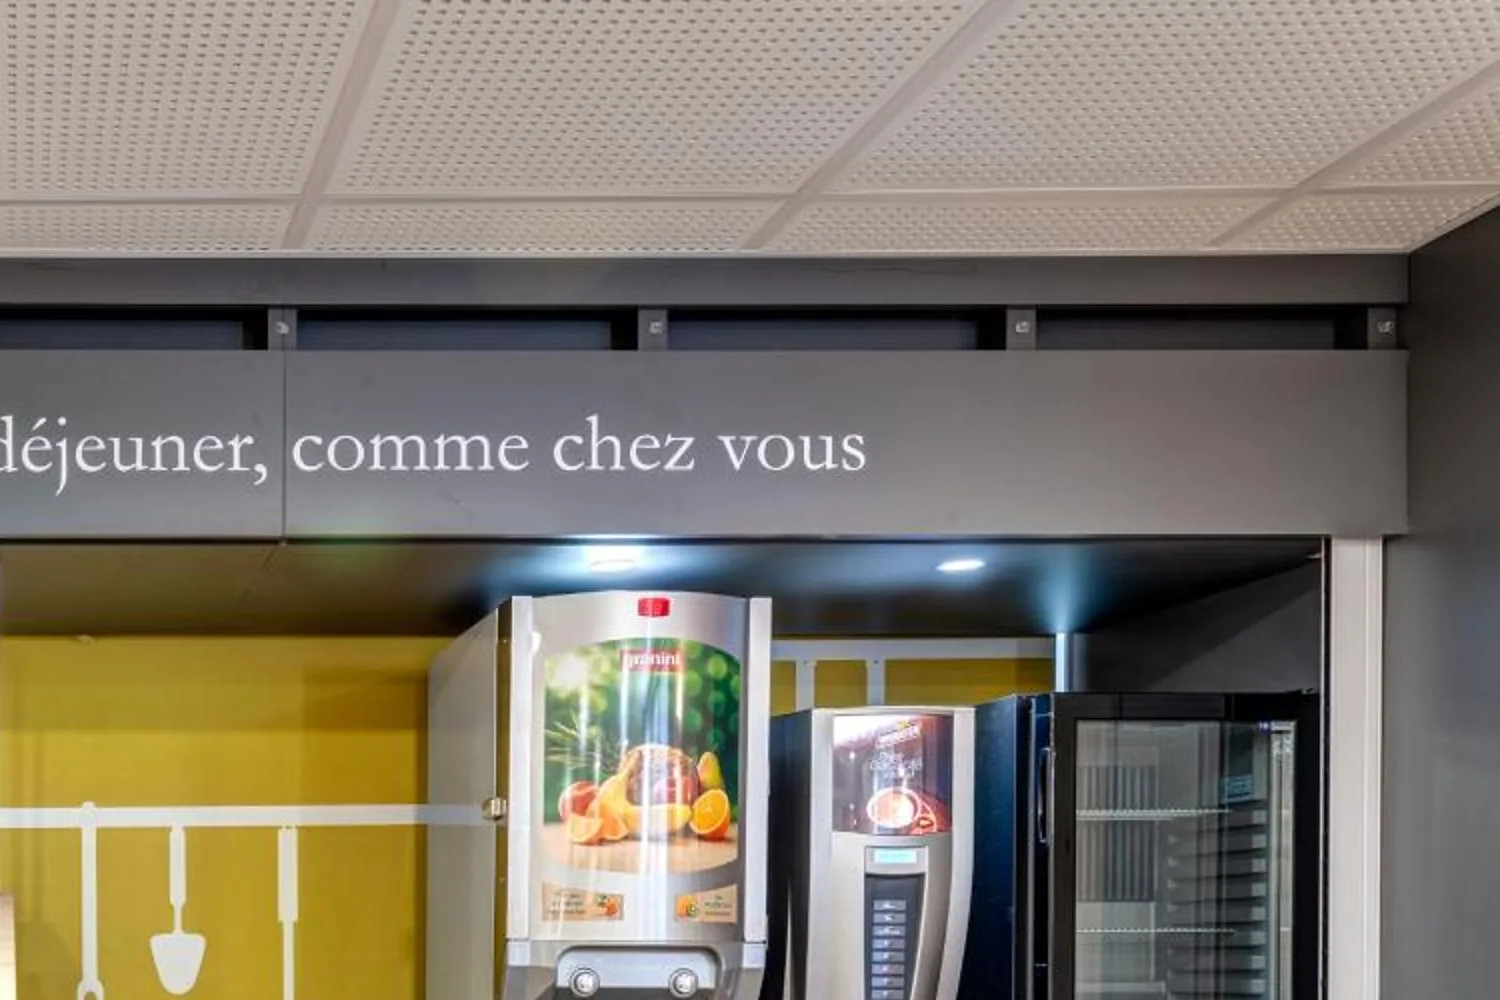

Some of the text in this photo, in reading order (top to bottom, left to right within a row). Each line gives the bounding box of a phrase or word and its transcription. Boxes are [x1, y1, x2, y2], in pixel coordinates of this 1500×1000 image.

[292, 433, 530, 472] comme
[553, 414, 695, 472] chez
[717, 433, 866, 472] vous
